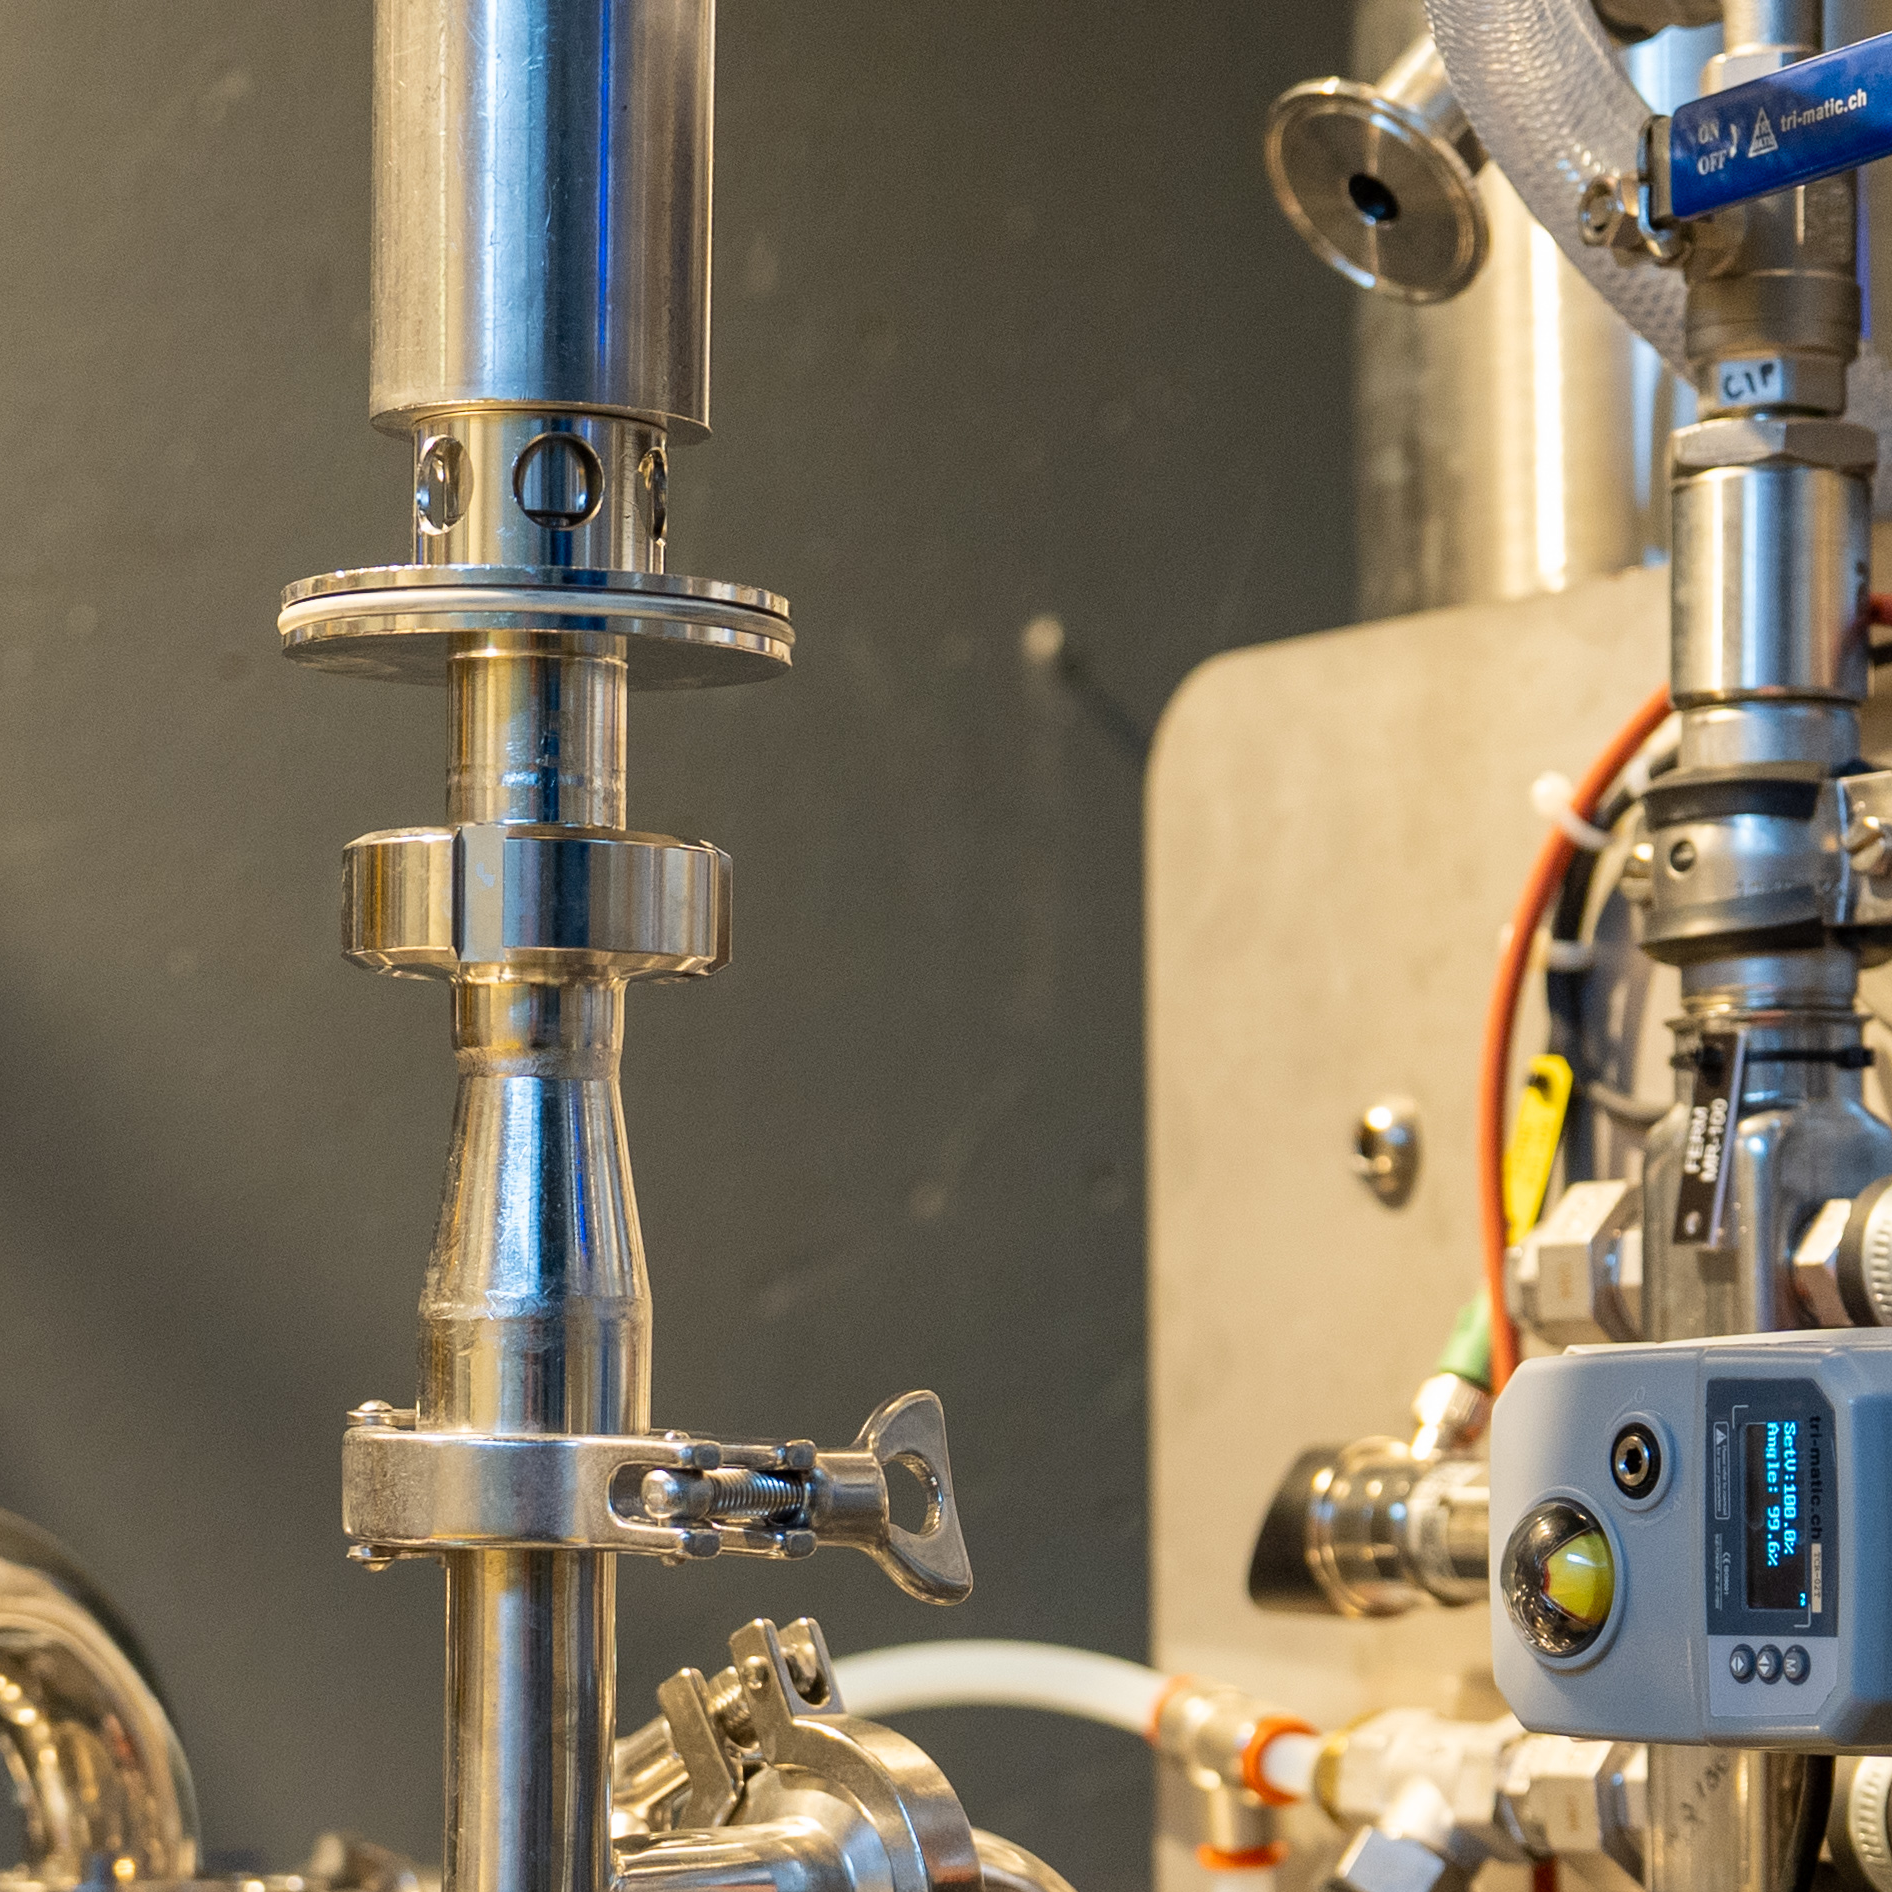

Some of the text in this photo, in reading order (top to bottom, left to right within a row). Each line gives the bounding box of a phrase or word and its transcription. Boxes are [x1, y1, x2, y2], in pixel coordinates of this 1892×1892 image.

[1698, 122, 1719, 144] ON
[1780, 88, 1868, 132] tri-matic.ch
[1697, 150, 1726, 175] OFF
[1684, 1106, 1709, 1174] FERM
[1699, 1098, 1728, 1182] MR-100
[1766, 1421, 1781, 1567] Angle: 99.6%
[1783, 1421, 1798, 1555] SetV:100.0%
[1810, 1416, 1822, 1598] tri-matic.ch TCR-02T
